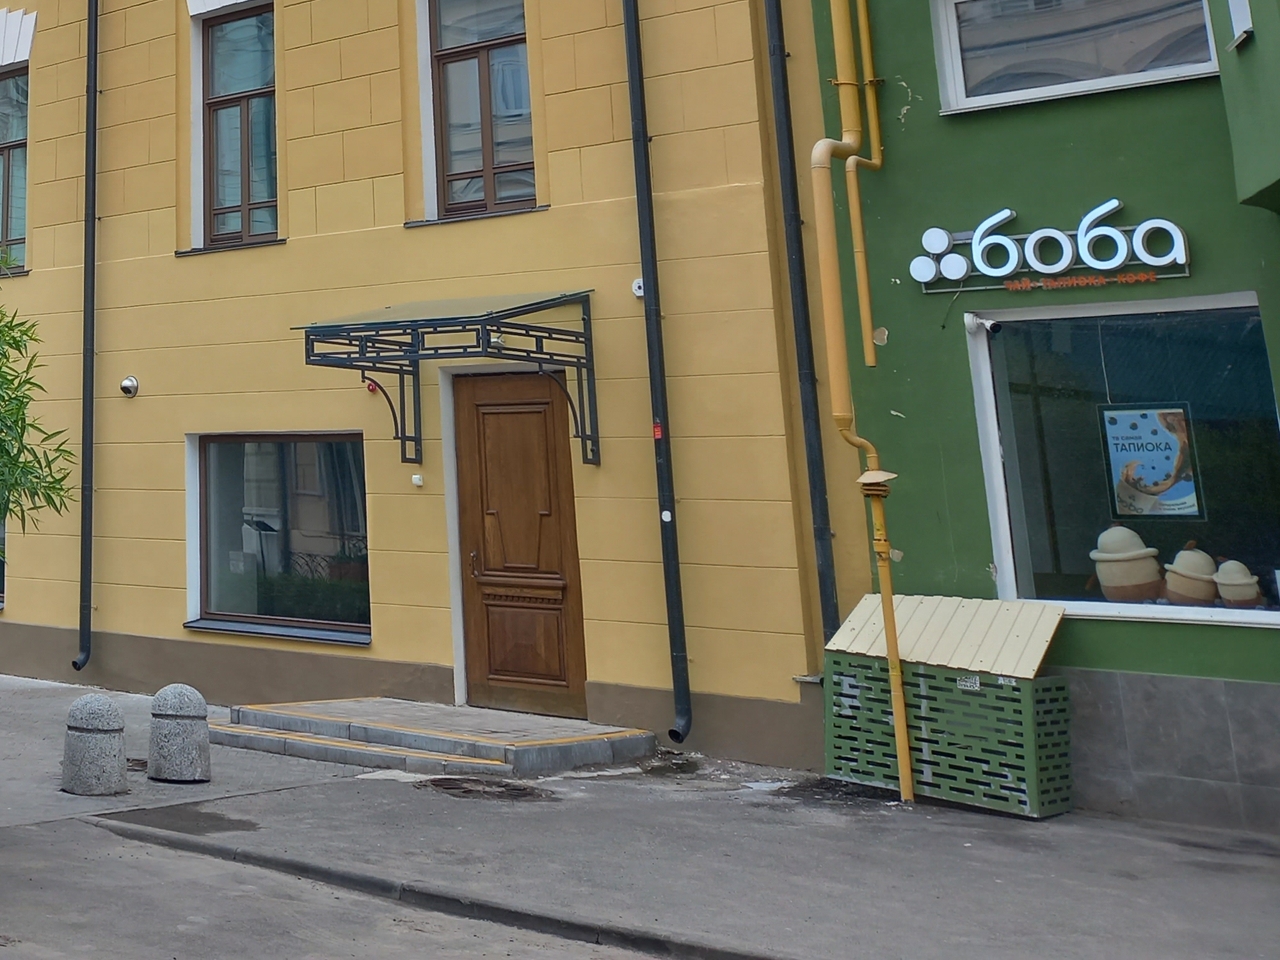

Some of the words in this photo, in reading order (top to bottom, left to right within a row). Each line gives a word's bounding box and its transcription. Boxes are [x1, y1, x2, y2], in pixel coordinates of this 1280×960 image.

[971, 198, 1189, 277] боба
[1004, 278, 1032, 291] ЧАЙ
[1040, 275, 1107, 290] ТАПИОКА
[1117, 271, 1157, 284] КОФЕ
[1113, 442, 1172, 452] ТАПИОКА
